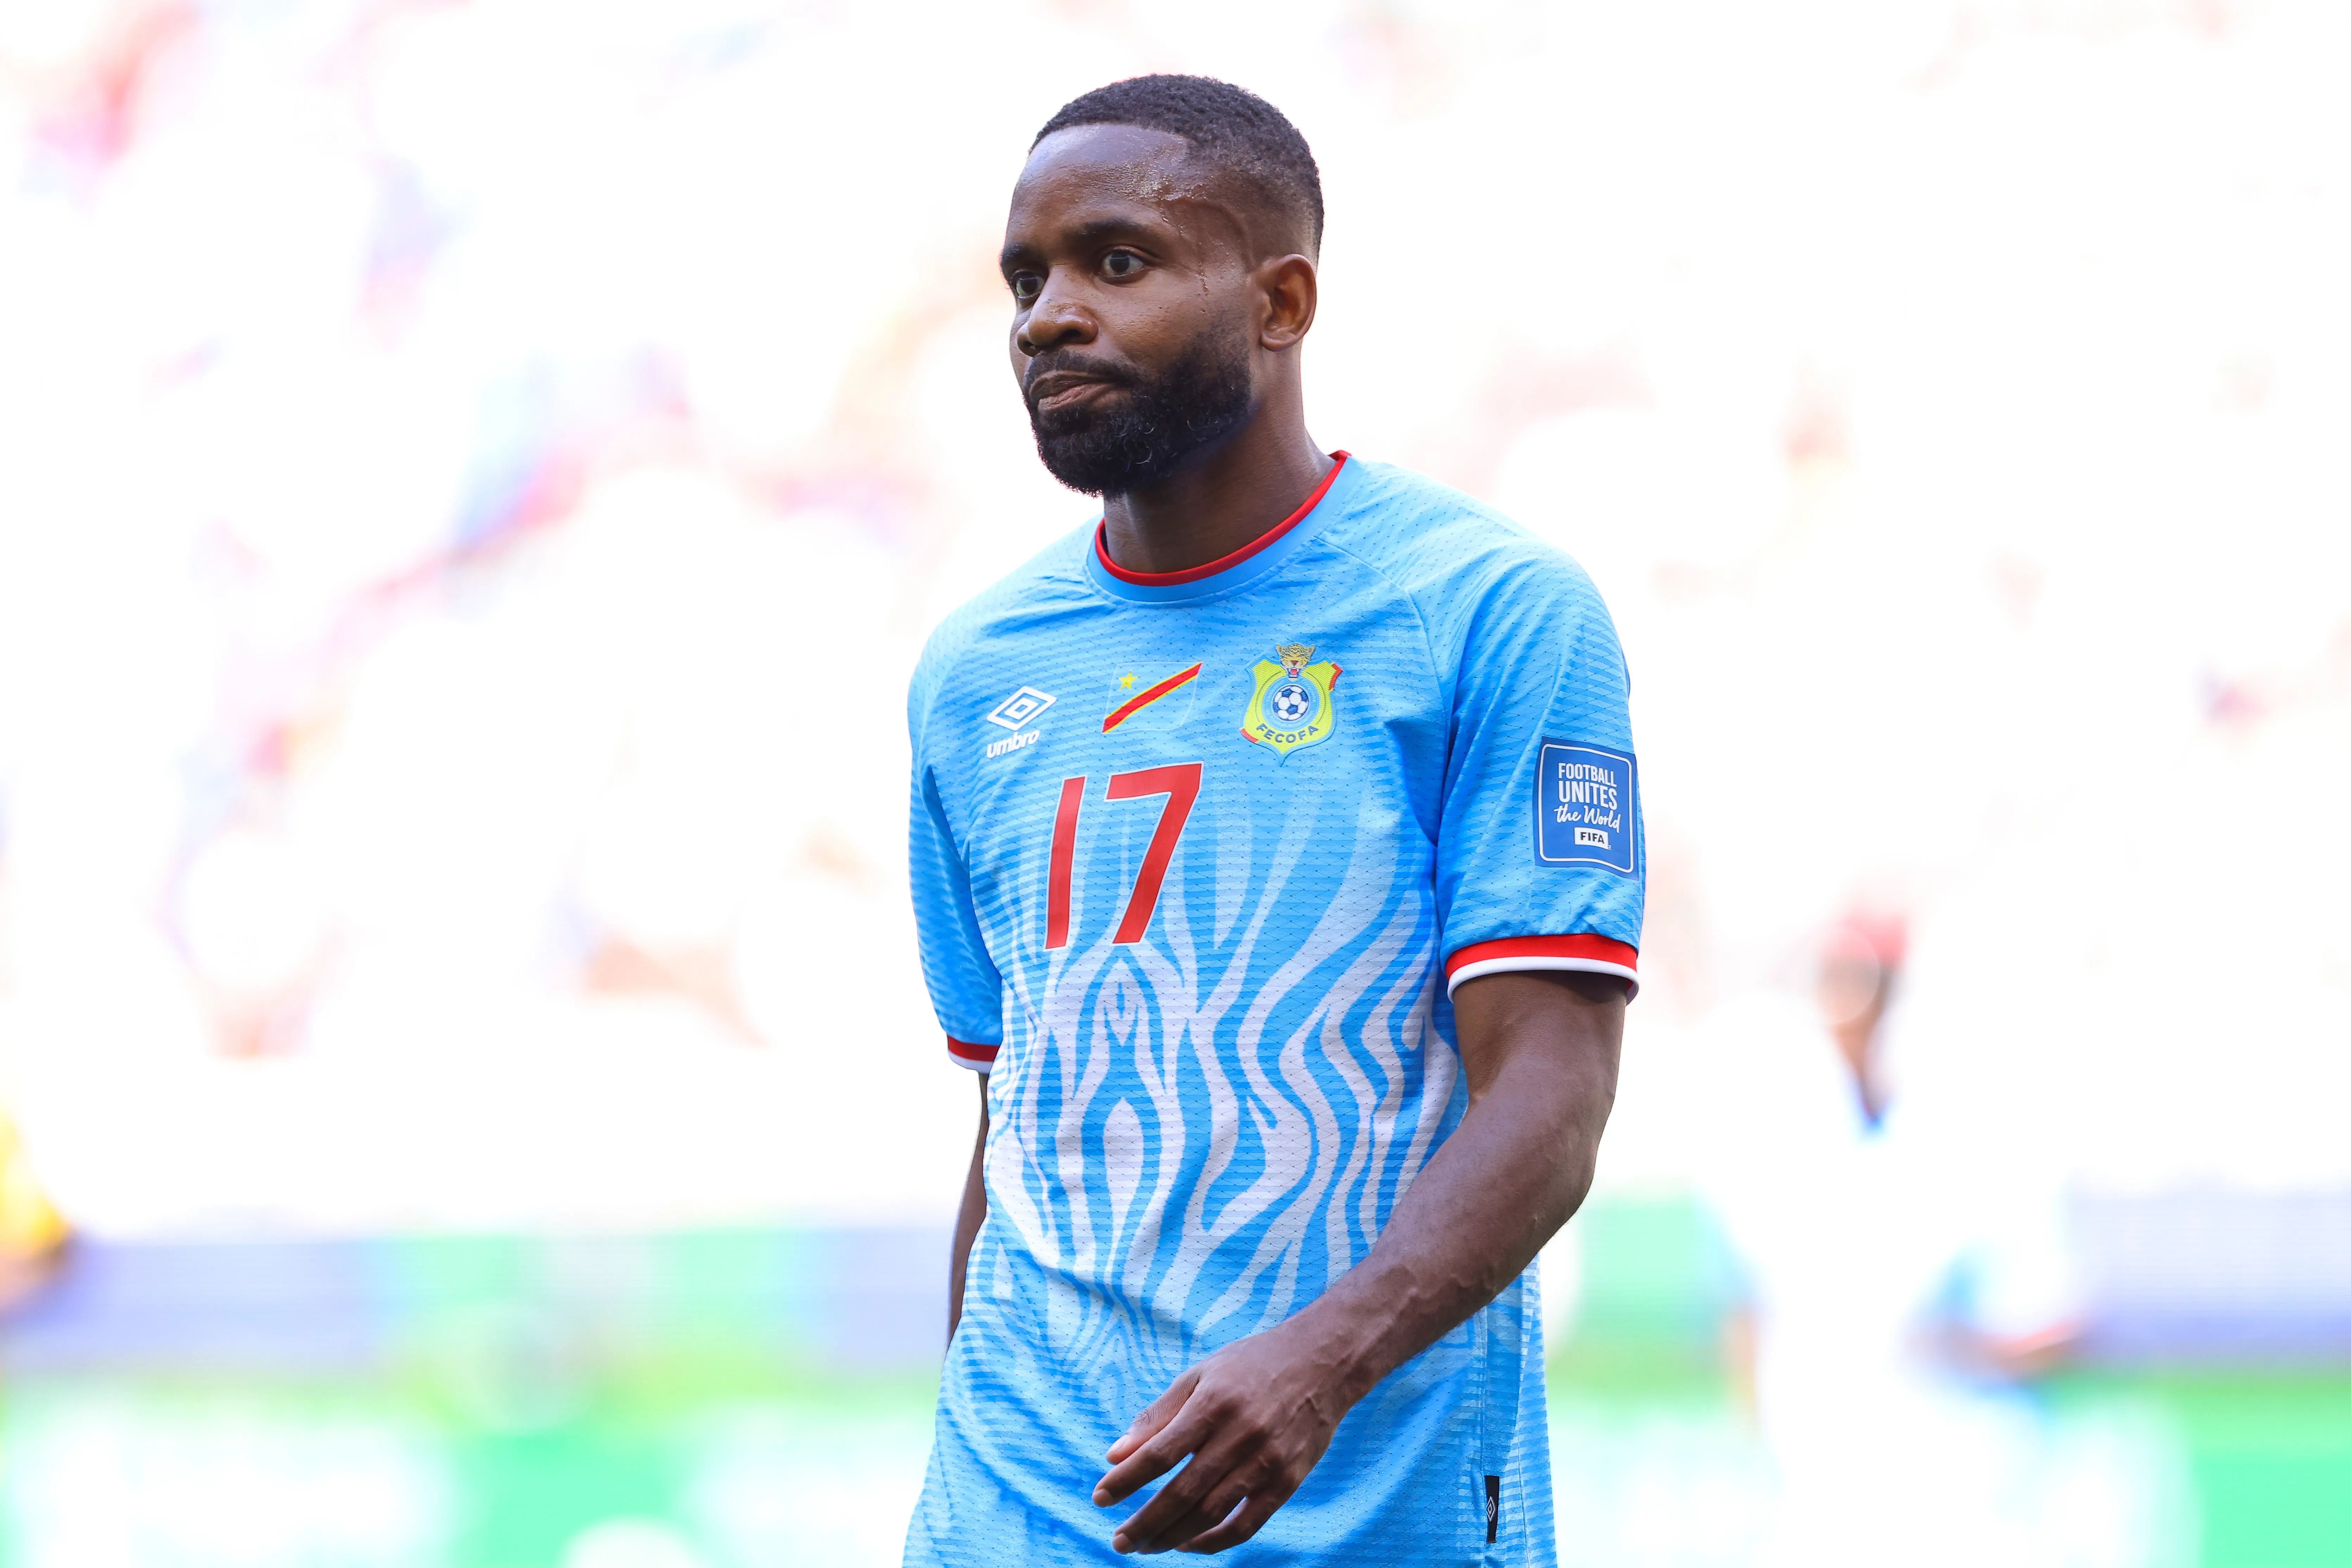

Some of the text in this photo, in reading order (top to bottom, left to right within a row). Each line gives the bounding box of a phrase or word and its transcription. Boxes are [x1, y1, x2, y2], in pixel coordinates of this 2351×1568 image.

[987, 730, 1040, 758] umbro
[1256, 723, 1319, 743] FECOFA
[1558, 763, 1617, 787] FOOTBALL
[1559, 780, 1618, 810] UNITES
[1554, 804, 1621, 833] the World
[1580, 832, 1605, 844] FIFA
[1044, 761, 1203, 951] 17
